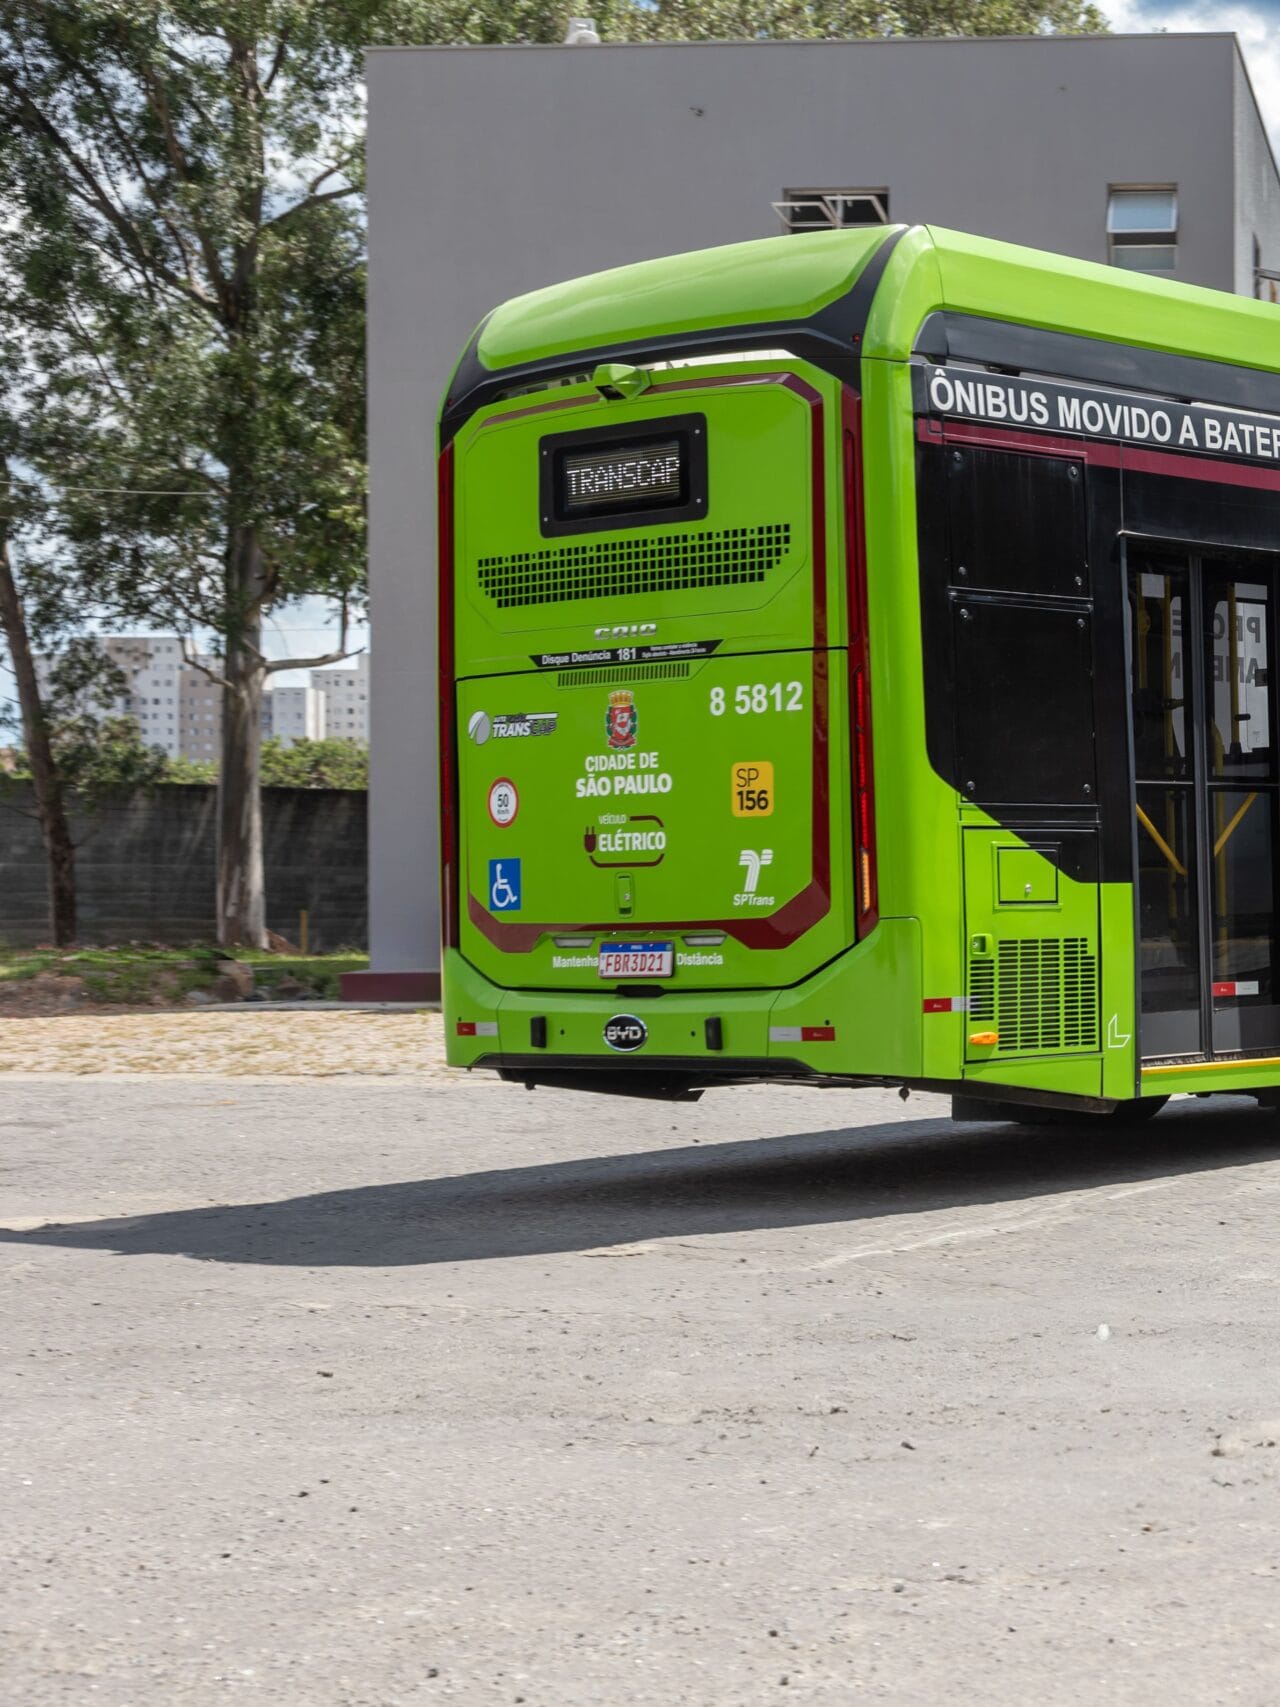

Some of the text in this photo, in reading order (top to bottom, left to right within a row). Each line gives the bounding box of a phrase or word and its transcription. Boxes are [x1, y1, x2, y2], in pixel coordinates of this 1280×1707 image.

[931, 369, 1049, 425] ÔNIBUS
[1058, 396, 1172, 443] MOVIDO
[1178, 415, 1198, 447] A
[567, 457, 680, 496] TRANSCAP
[541, 653, 570, 666] Disque
[571, 650, 611, 664] Denúncia
[616, 647, 637, 661] 181
[710, 681, 804, 716] 8 5812
[585, 752, 659, 772] CIDADE DE
[576, 773, 672, 798] SÃO PAULO
[736, 767, 759, 788] SP
[497, 793, 509, 808] 50
[736, 789, 769, 811] 156
[599, 812, 627, 825] VEÍCULO
[598, 829, 666, 852] ELÉTRICO
[733, 893, 775, 906] SPTrans
[552, 952, 723, 968] Mantenha Distância
[605, 953, 664, 972] FBR3D21
[607, 1026, 642, 1041] BYD
